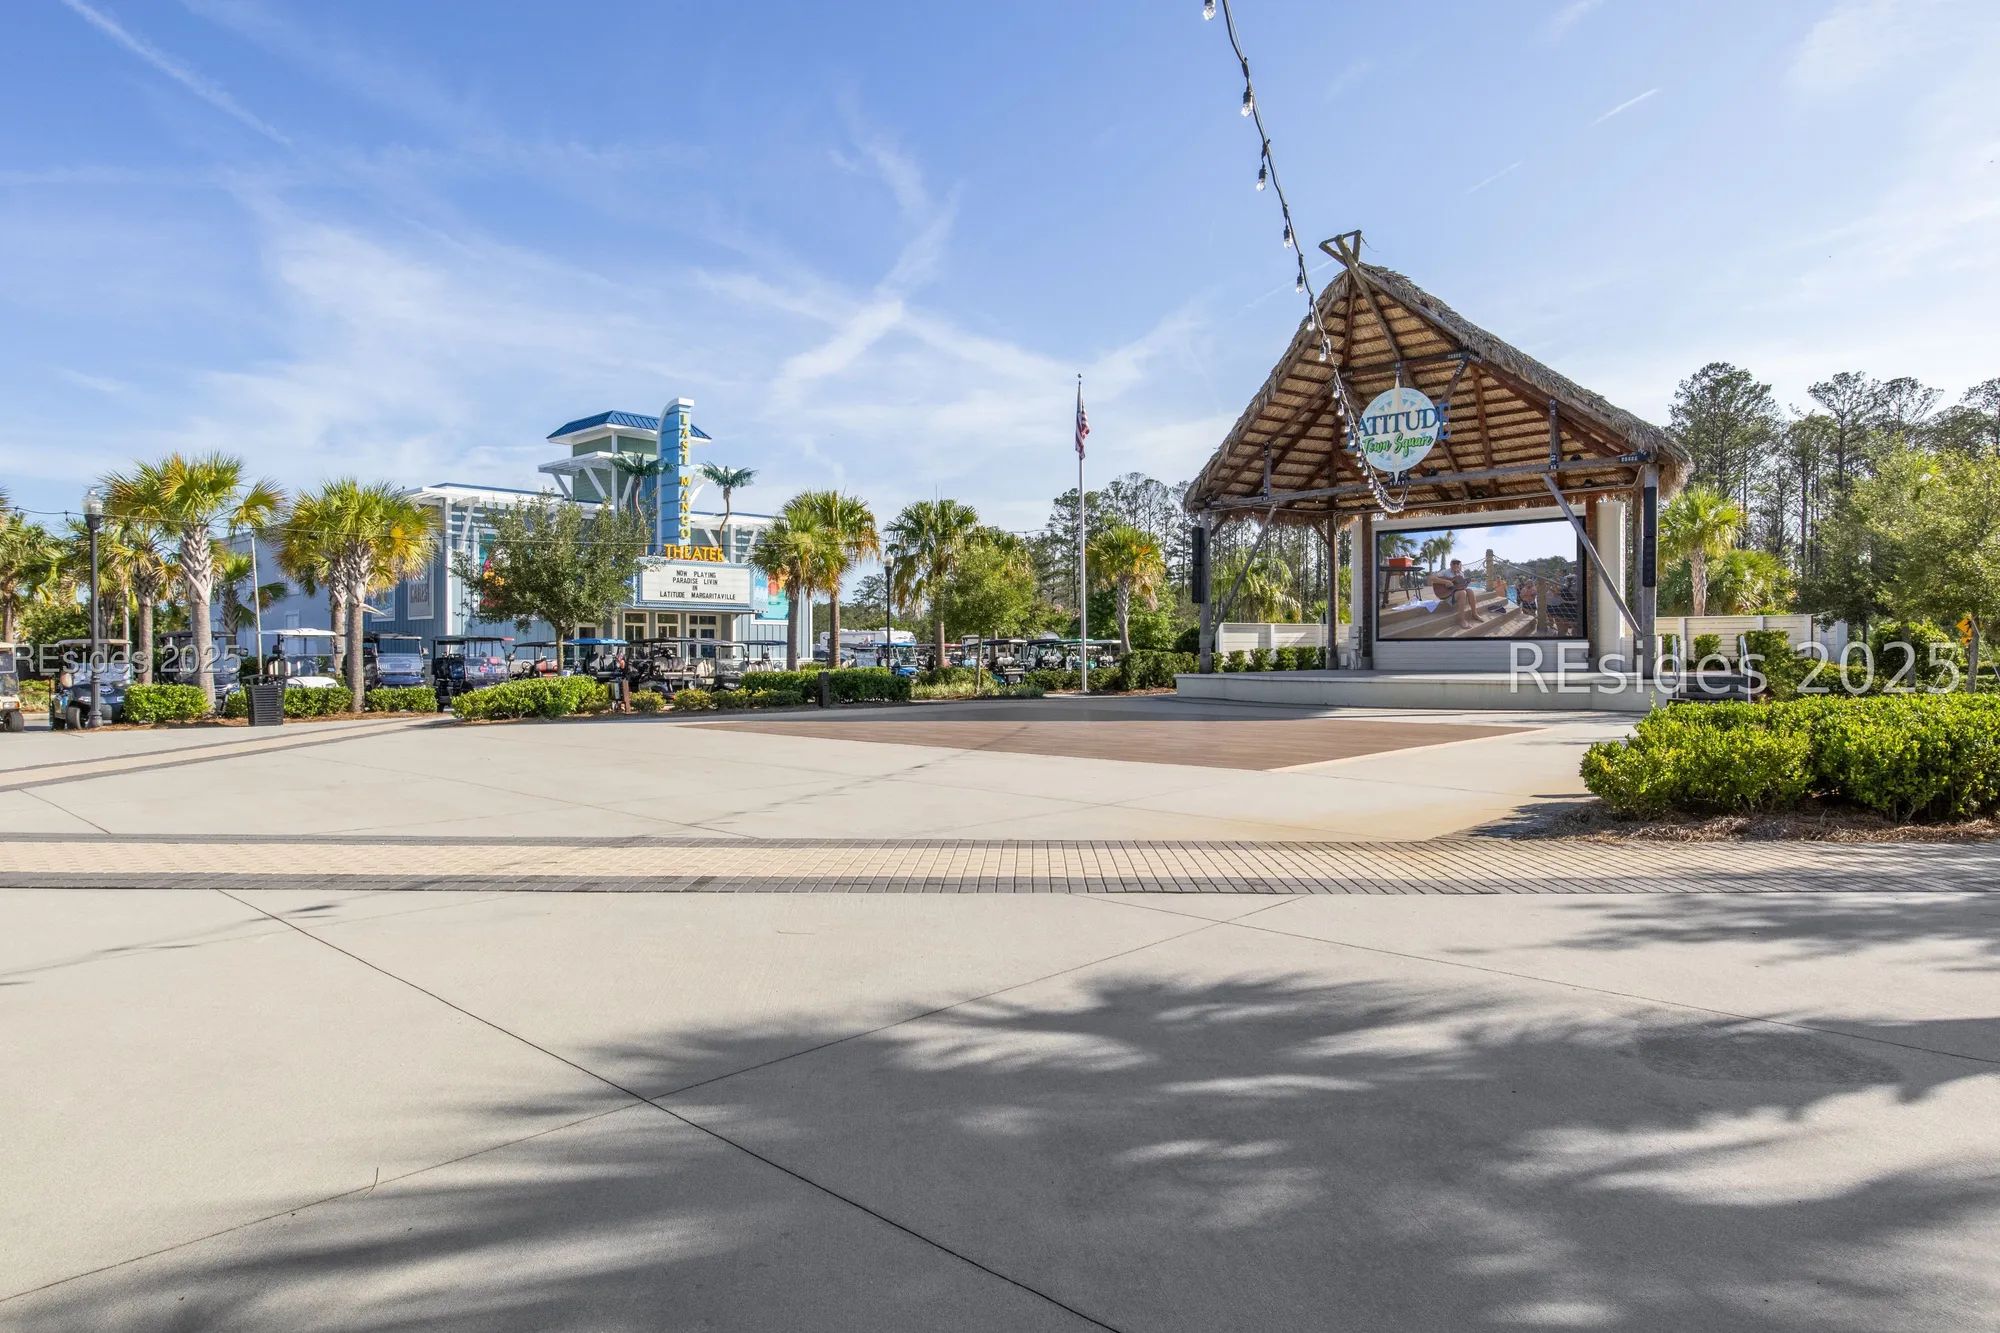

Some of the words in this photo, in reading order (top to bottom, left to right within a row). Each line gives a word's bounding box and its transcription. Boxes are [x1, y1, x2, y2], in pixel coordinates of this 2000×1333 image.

[680, 414, 690, 465] LAST
[1362, 437, 1392, 456] Town
[1394, 432, 1433, 457] Square
[679, 476, 691, 539] MANGO
[664, 544, 725, 562] THEATER
[691, 592, 736, 600] MARGARITAVILLE
